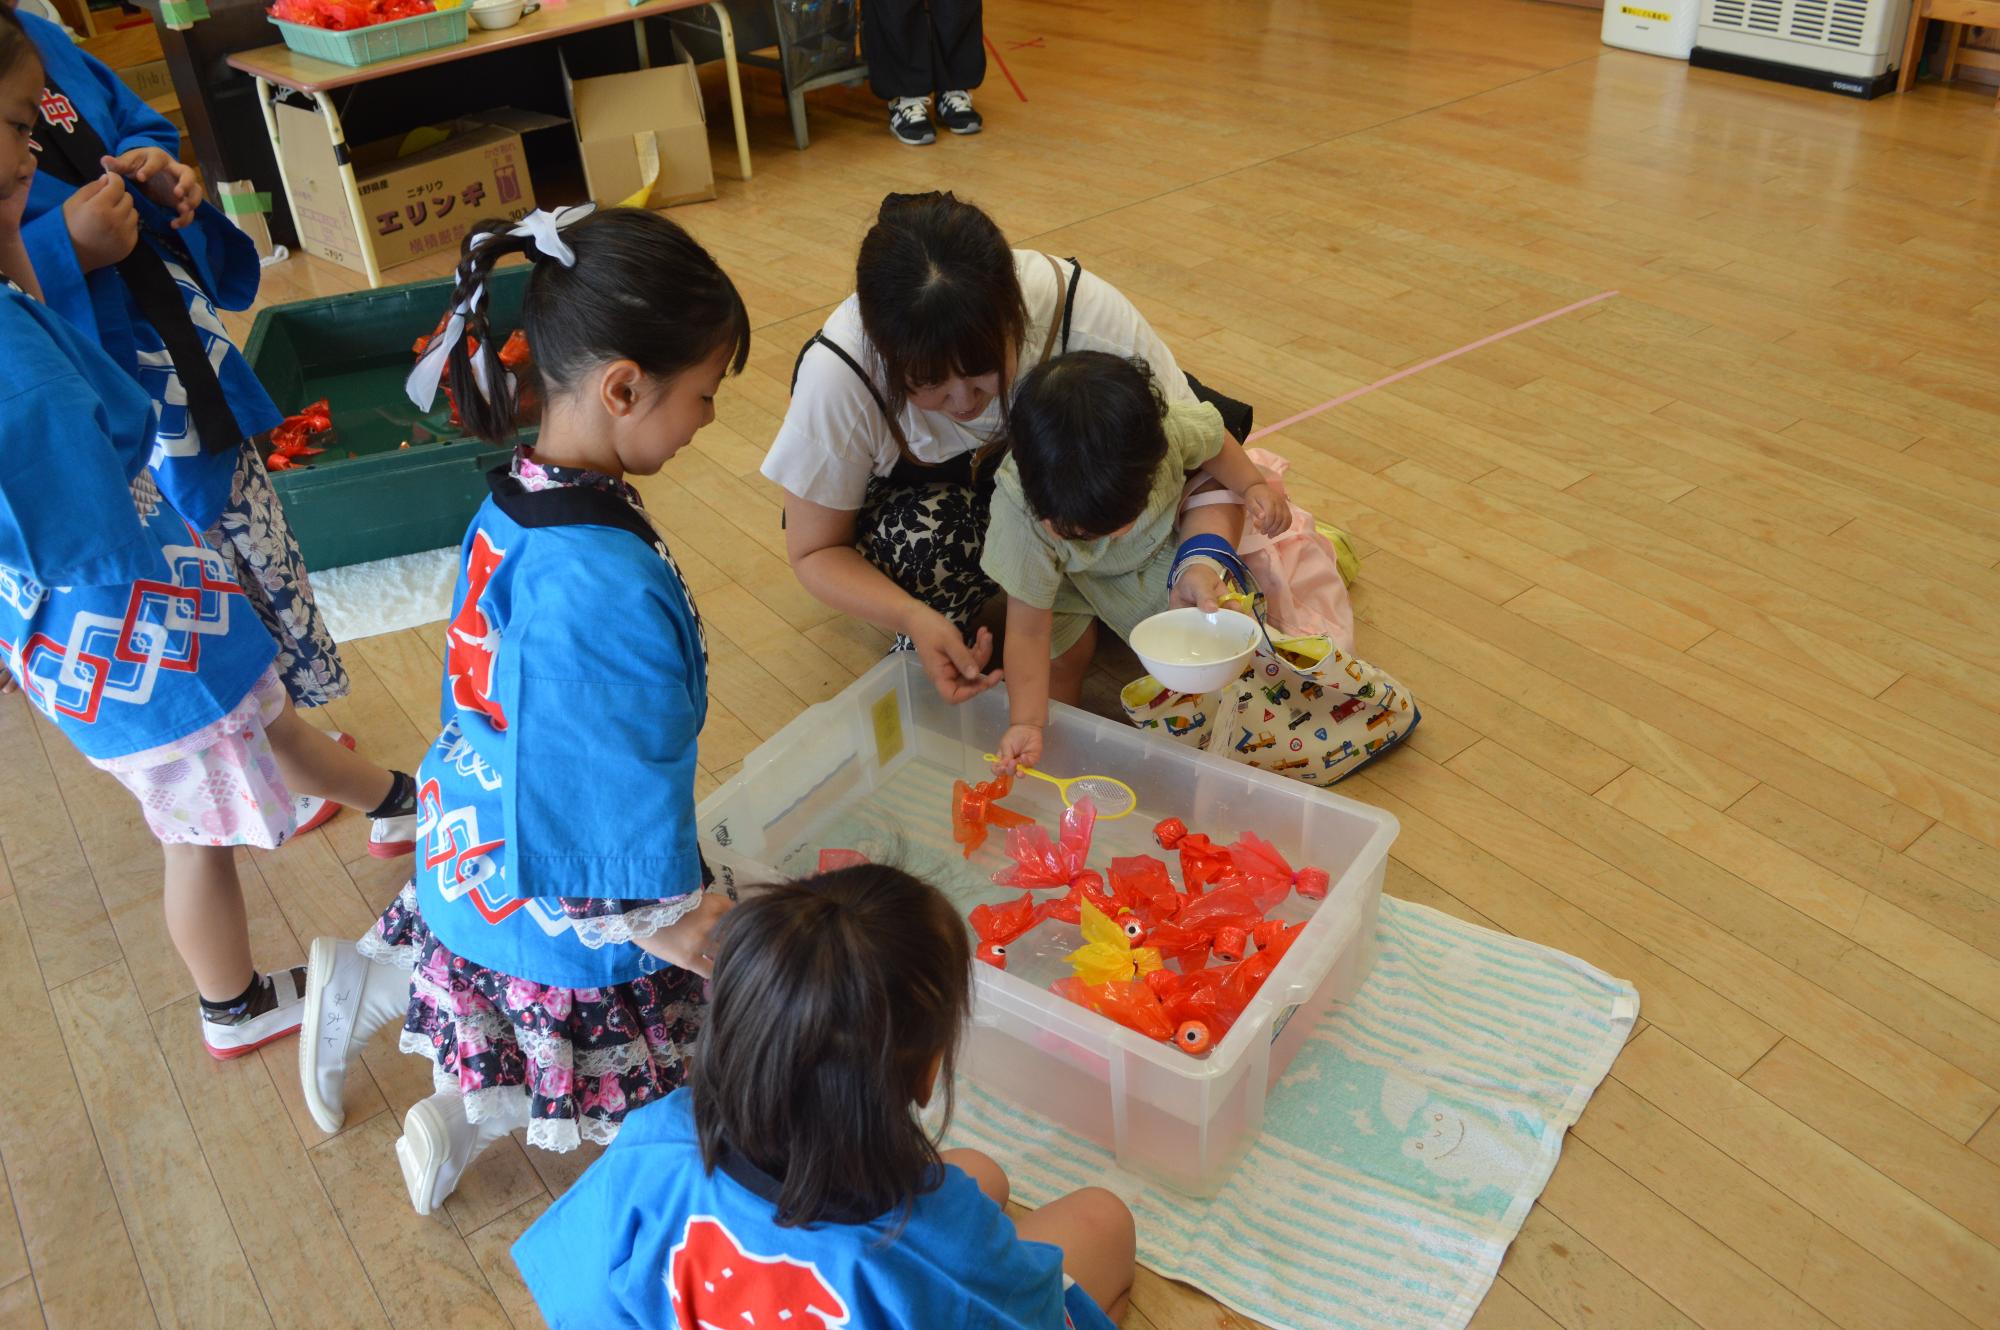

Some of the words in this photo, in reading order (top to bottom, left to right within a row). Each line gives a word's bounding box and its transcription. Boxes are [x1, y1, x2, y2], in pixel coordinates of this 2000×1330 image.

[1832, 81, 1863, 93] TOSHIBA
[407, 180, 444, 198] ニチリウ
[376, 181, 486, 236] エリンギ
